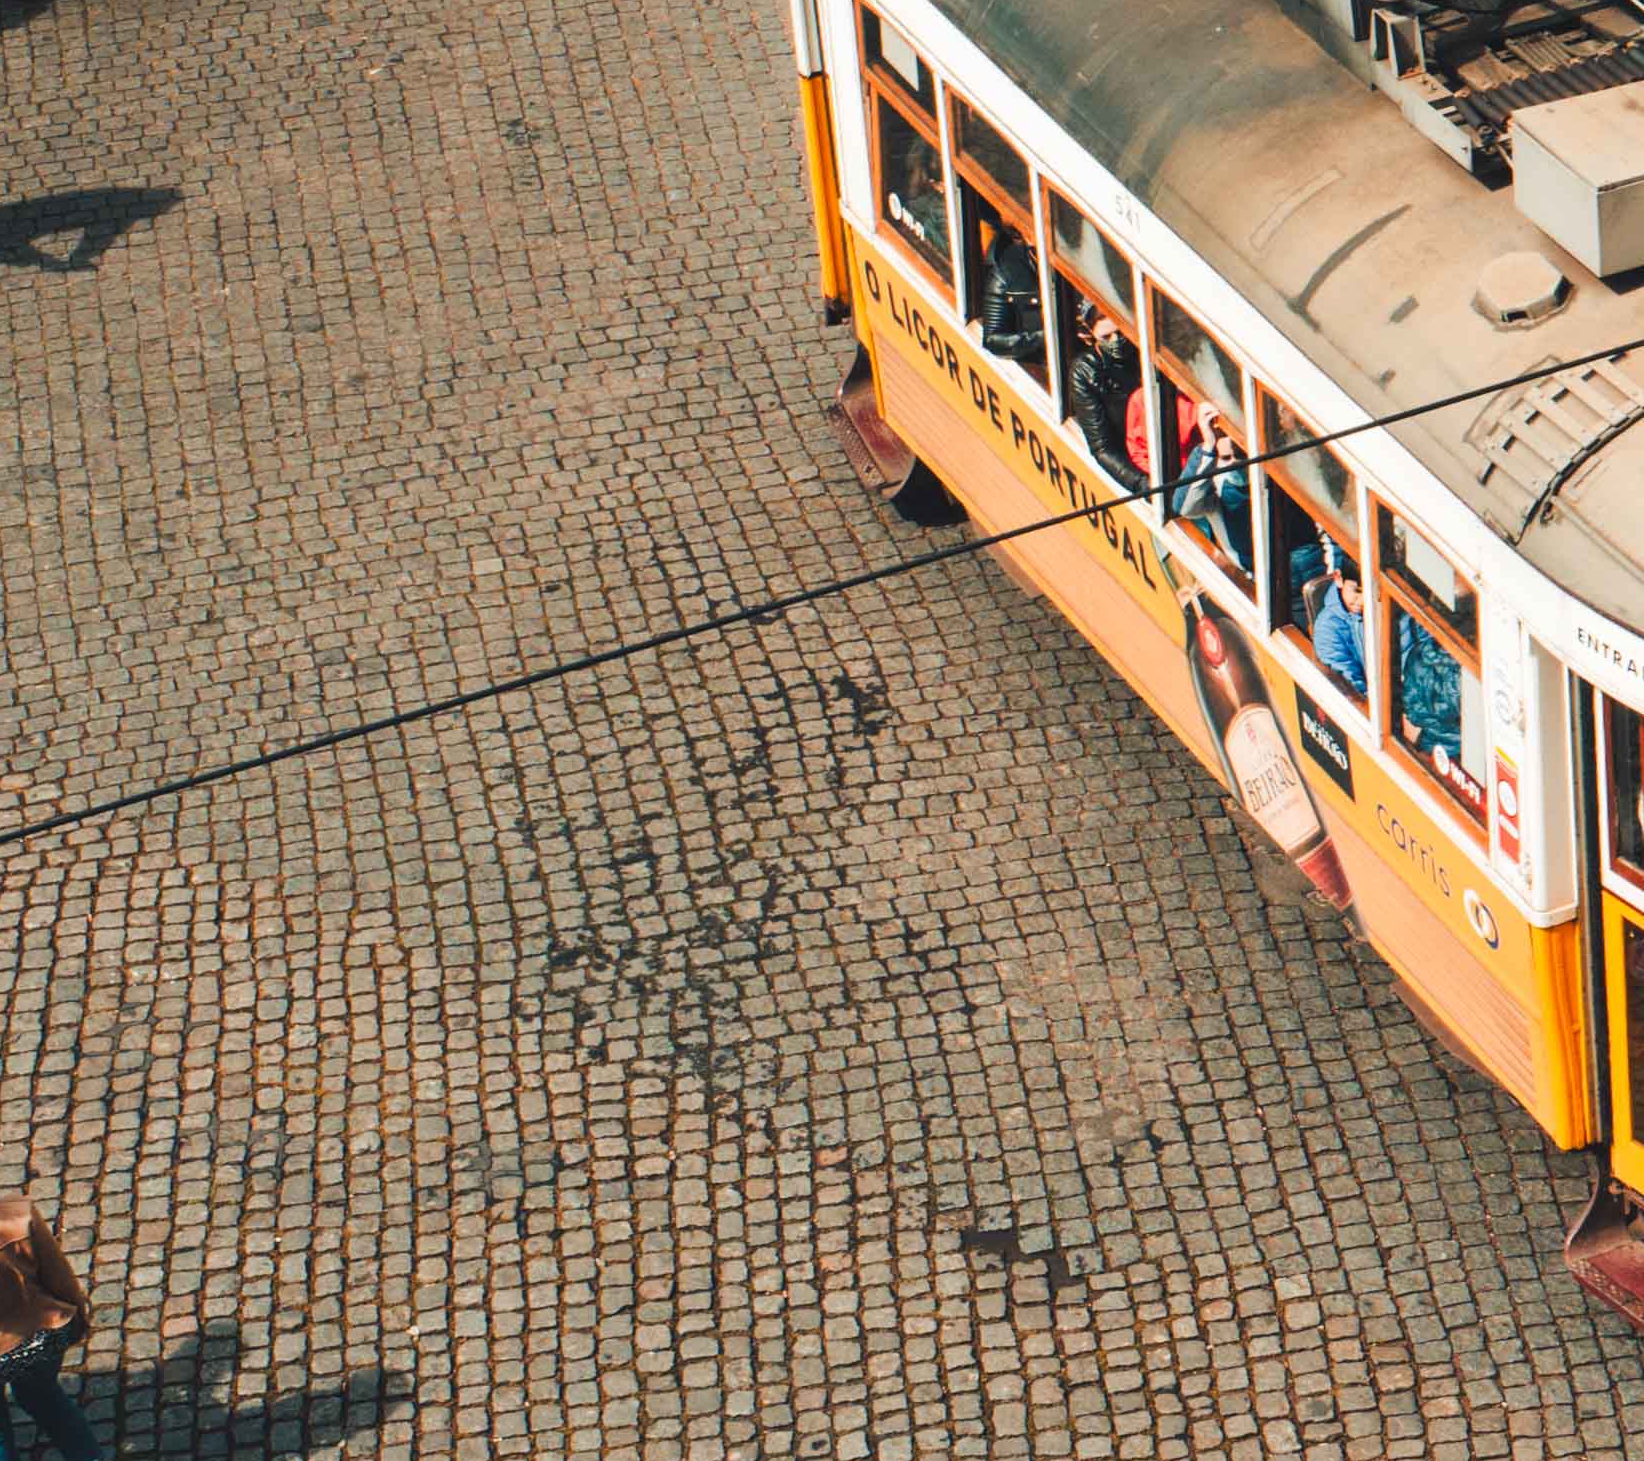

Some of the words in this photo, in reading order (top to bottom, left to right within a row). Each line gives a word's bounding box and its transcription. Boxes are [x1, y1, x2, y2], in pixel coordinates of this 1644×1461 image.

[864, 259, 881, 305] O
[886, 283, 965, 394] LICOR
[968, 378, 1005, 432] DE
[1009, 408, 1157, 590] PORTUGAL
[1376, 803, 1451, 898] carris
